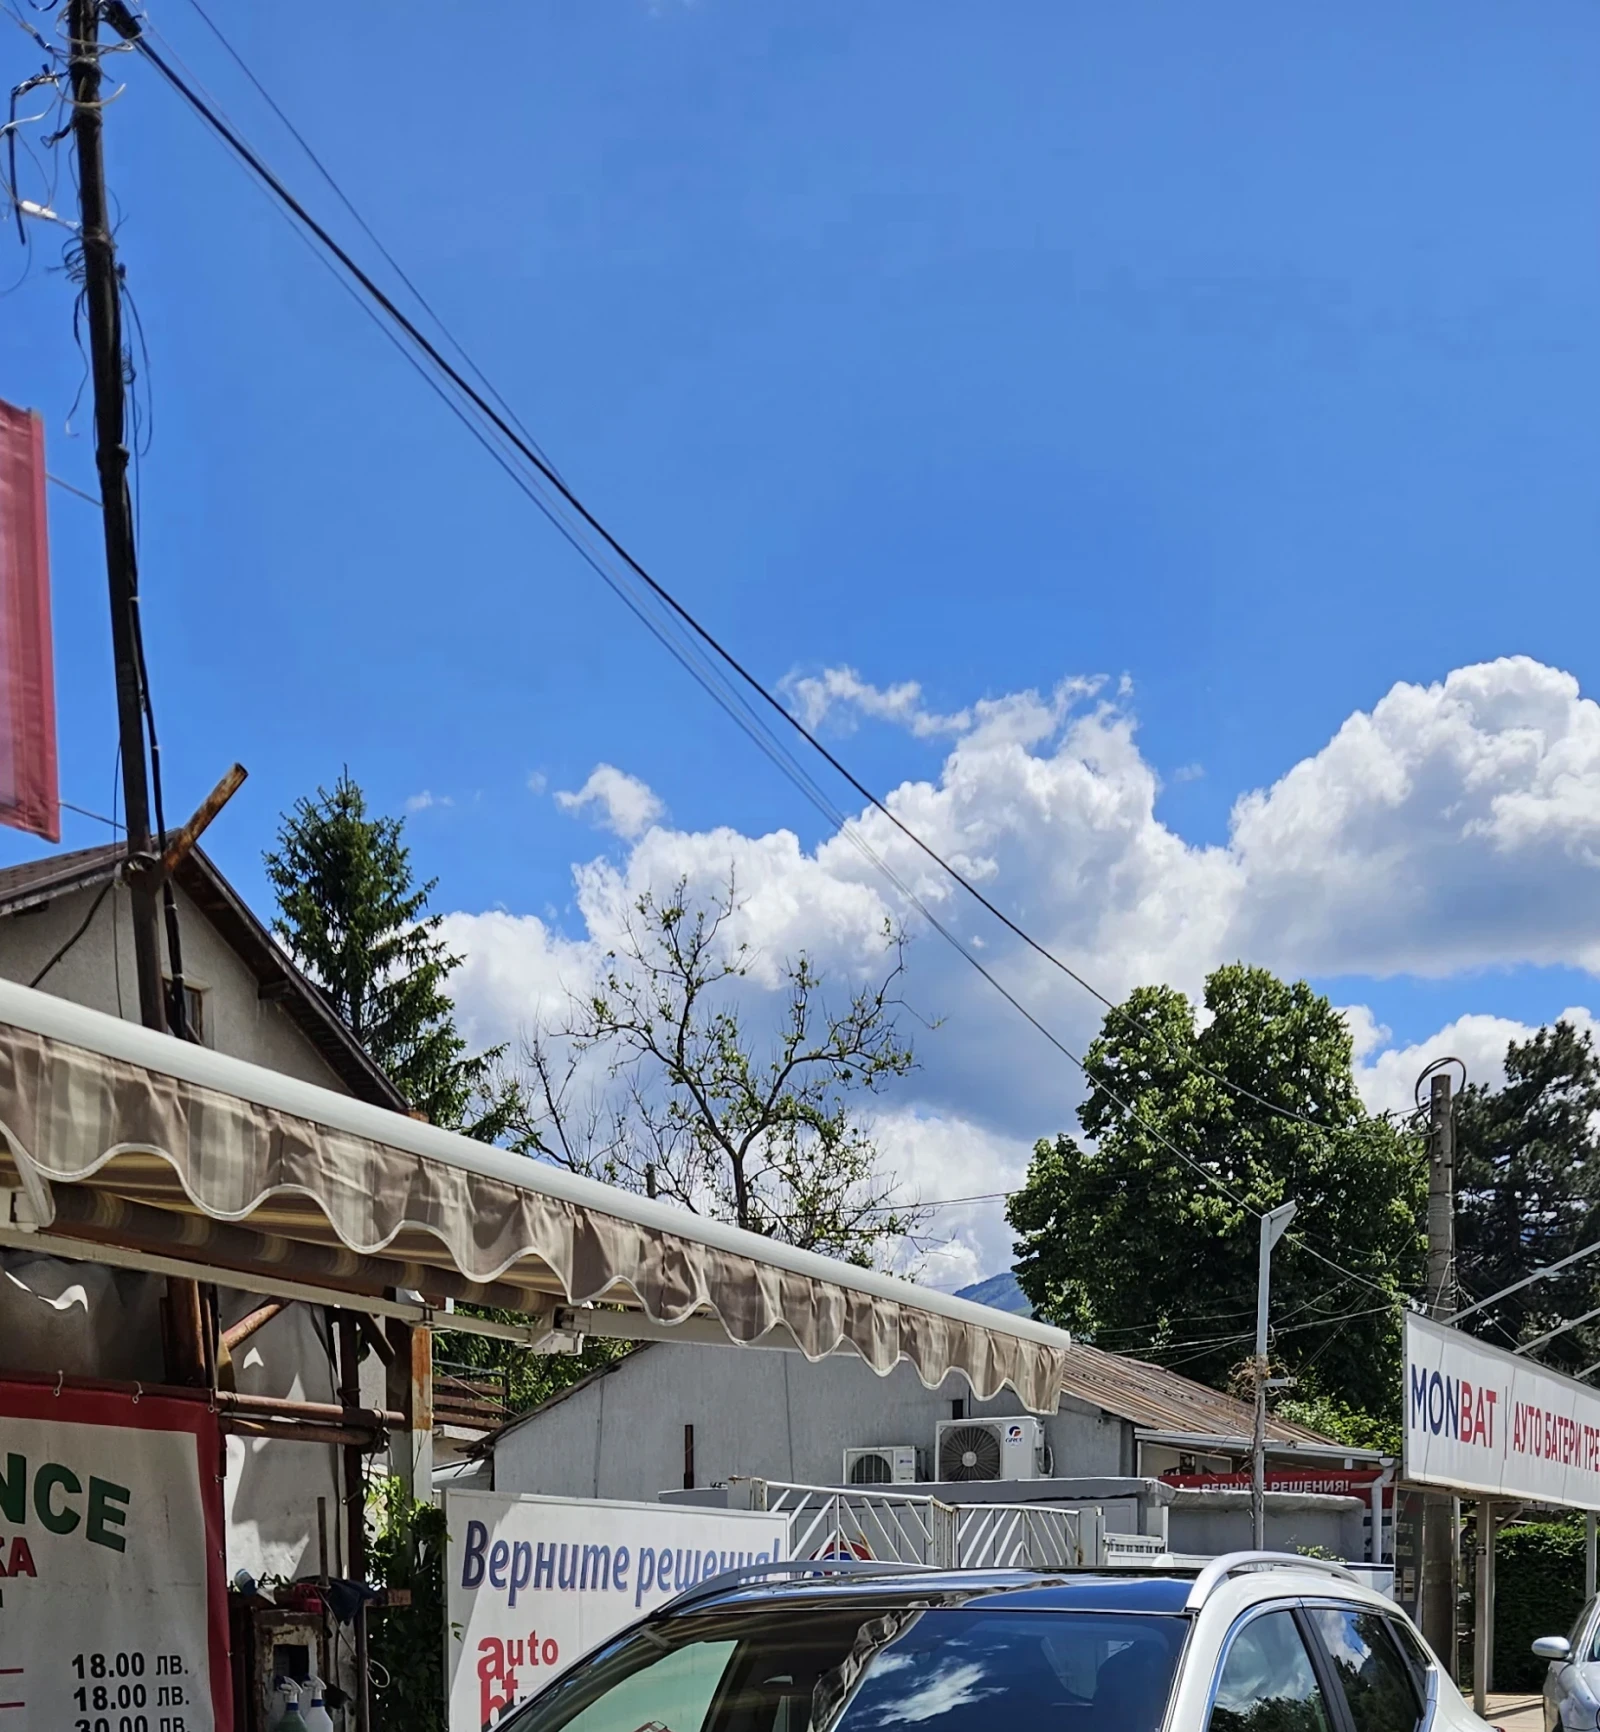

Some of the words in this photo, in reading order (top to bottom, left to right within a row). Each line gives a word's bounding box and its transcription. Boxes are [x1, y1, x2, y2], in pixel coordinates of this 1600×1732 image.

[1411, 1363, 1497, 1449] MONBAT
[1513, 1401, 1542, 1458] АУТО
[1544, 1412, 1582, 1468] БАТЕРИ
[461, 1519, 631, 1609] Верните
[71, 1652, 145, 1679] 18.00
[477, 1629, 559, 1681] auto
[73, 1683, 147, 1712] 18.00
